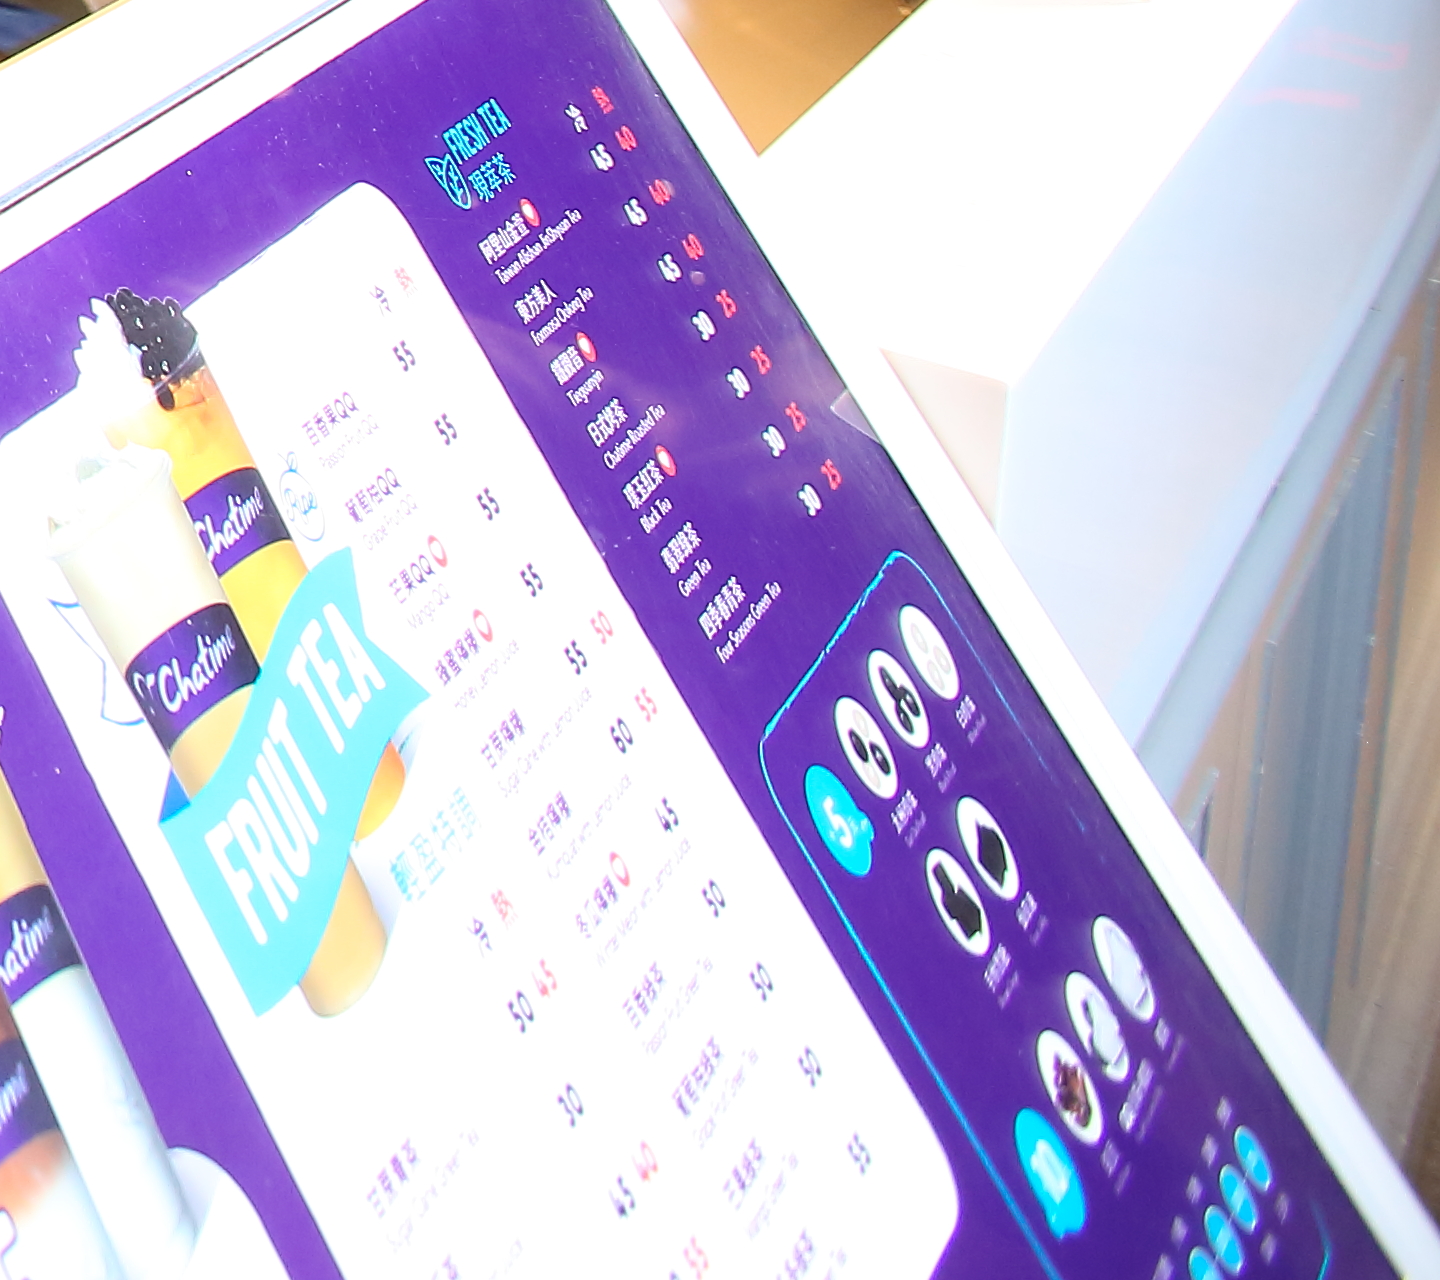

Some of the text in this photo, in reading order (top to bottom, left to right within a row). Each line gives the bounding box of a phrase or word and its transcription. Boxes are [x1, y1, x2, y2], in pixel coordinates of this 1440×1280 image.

[442, 97, 513, 165] FRESH TEA
[564, 102, 589, 134] 冷
[589, 124, 639, 173] 45 40
[468, 151, 517, 203] 現萃茶
[622, 196, 649, 227] 45
[494, 256, 521, 285] Taiwan
[564, 208, 583, 224] Tea
[656, 233, 705, 283] 45 40
[513, 278, 559, 325] 東方美人
[529, 318, 562, 347] Formosa
[575, 286, 595, 301] Tea
[690, 289, 737, 342] 30 25
[392, 340, 417, 373] 55
[725, 344, 773, 400] 30 25
[433, 412, 458, 447] 55
[648, 404, 668, 422] Tea
[761, 401, 808, 458] 30 25
[476, 486, 501, 521] 55
[797, 458, 843, 517] 30 25
[638, 496, 674, 535] Black Tea
[519, 562, 544, 598] 55
[677, 557, 714, 598] Green Tea
[763, 580, 783, 600] Tea
[563, 610, 614, 676] 55 50
[156, 623, 237, 714] Chatime
[609, 686, 659, 755] 60 55
[203, 602, 387, 947] FRUIT TEA
[654, 796, 680, 834] 45
[701, 879, 726, 918] 50
[507, 958, 559, 1034] 50 45
[749, 961, 774, 1002] 50
